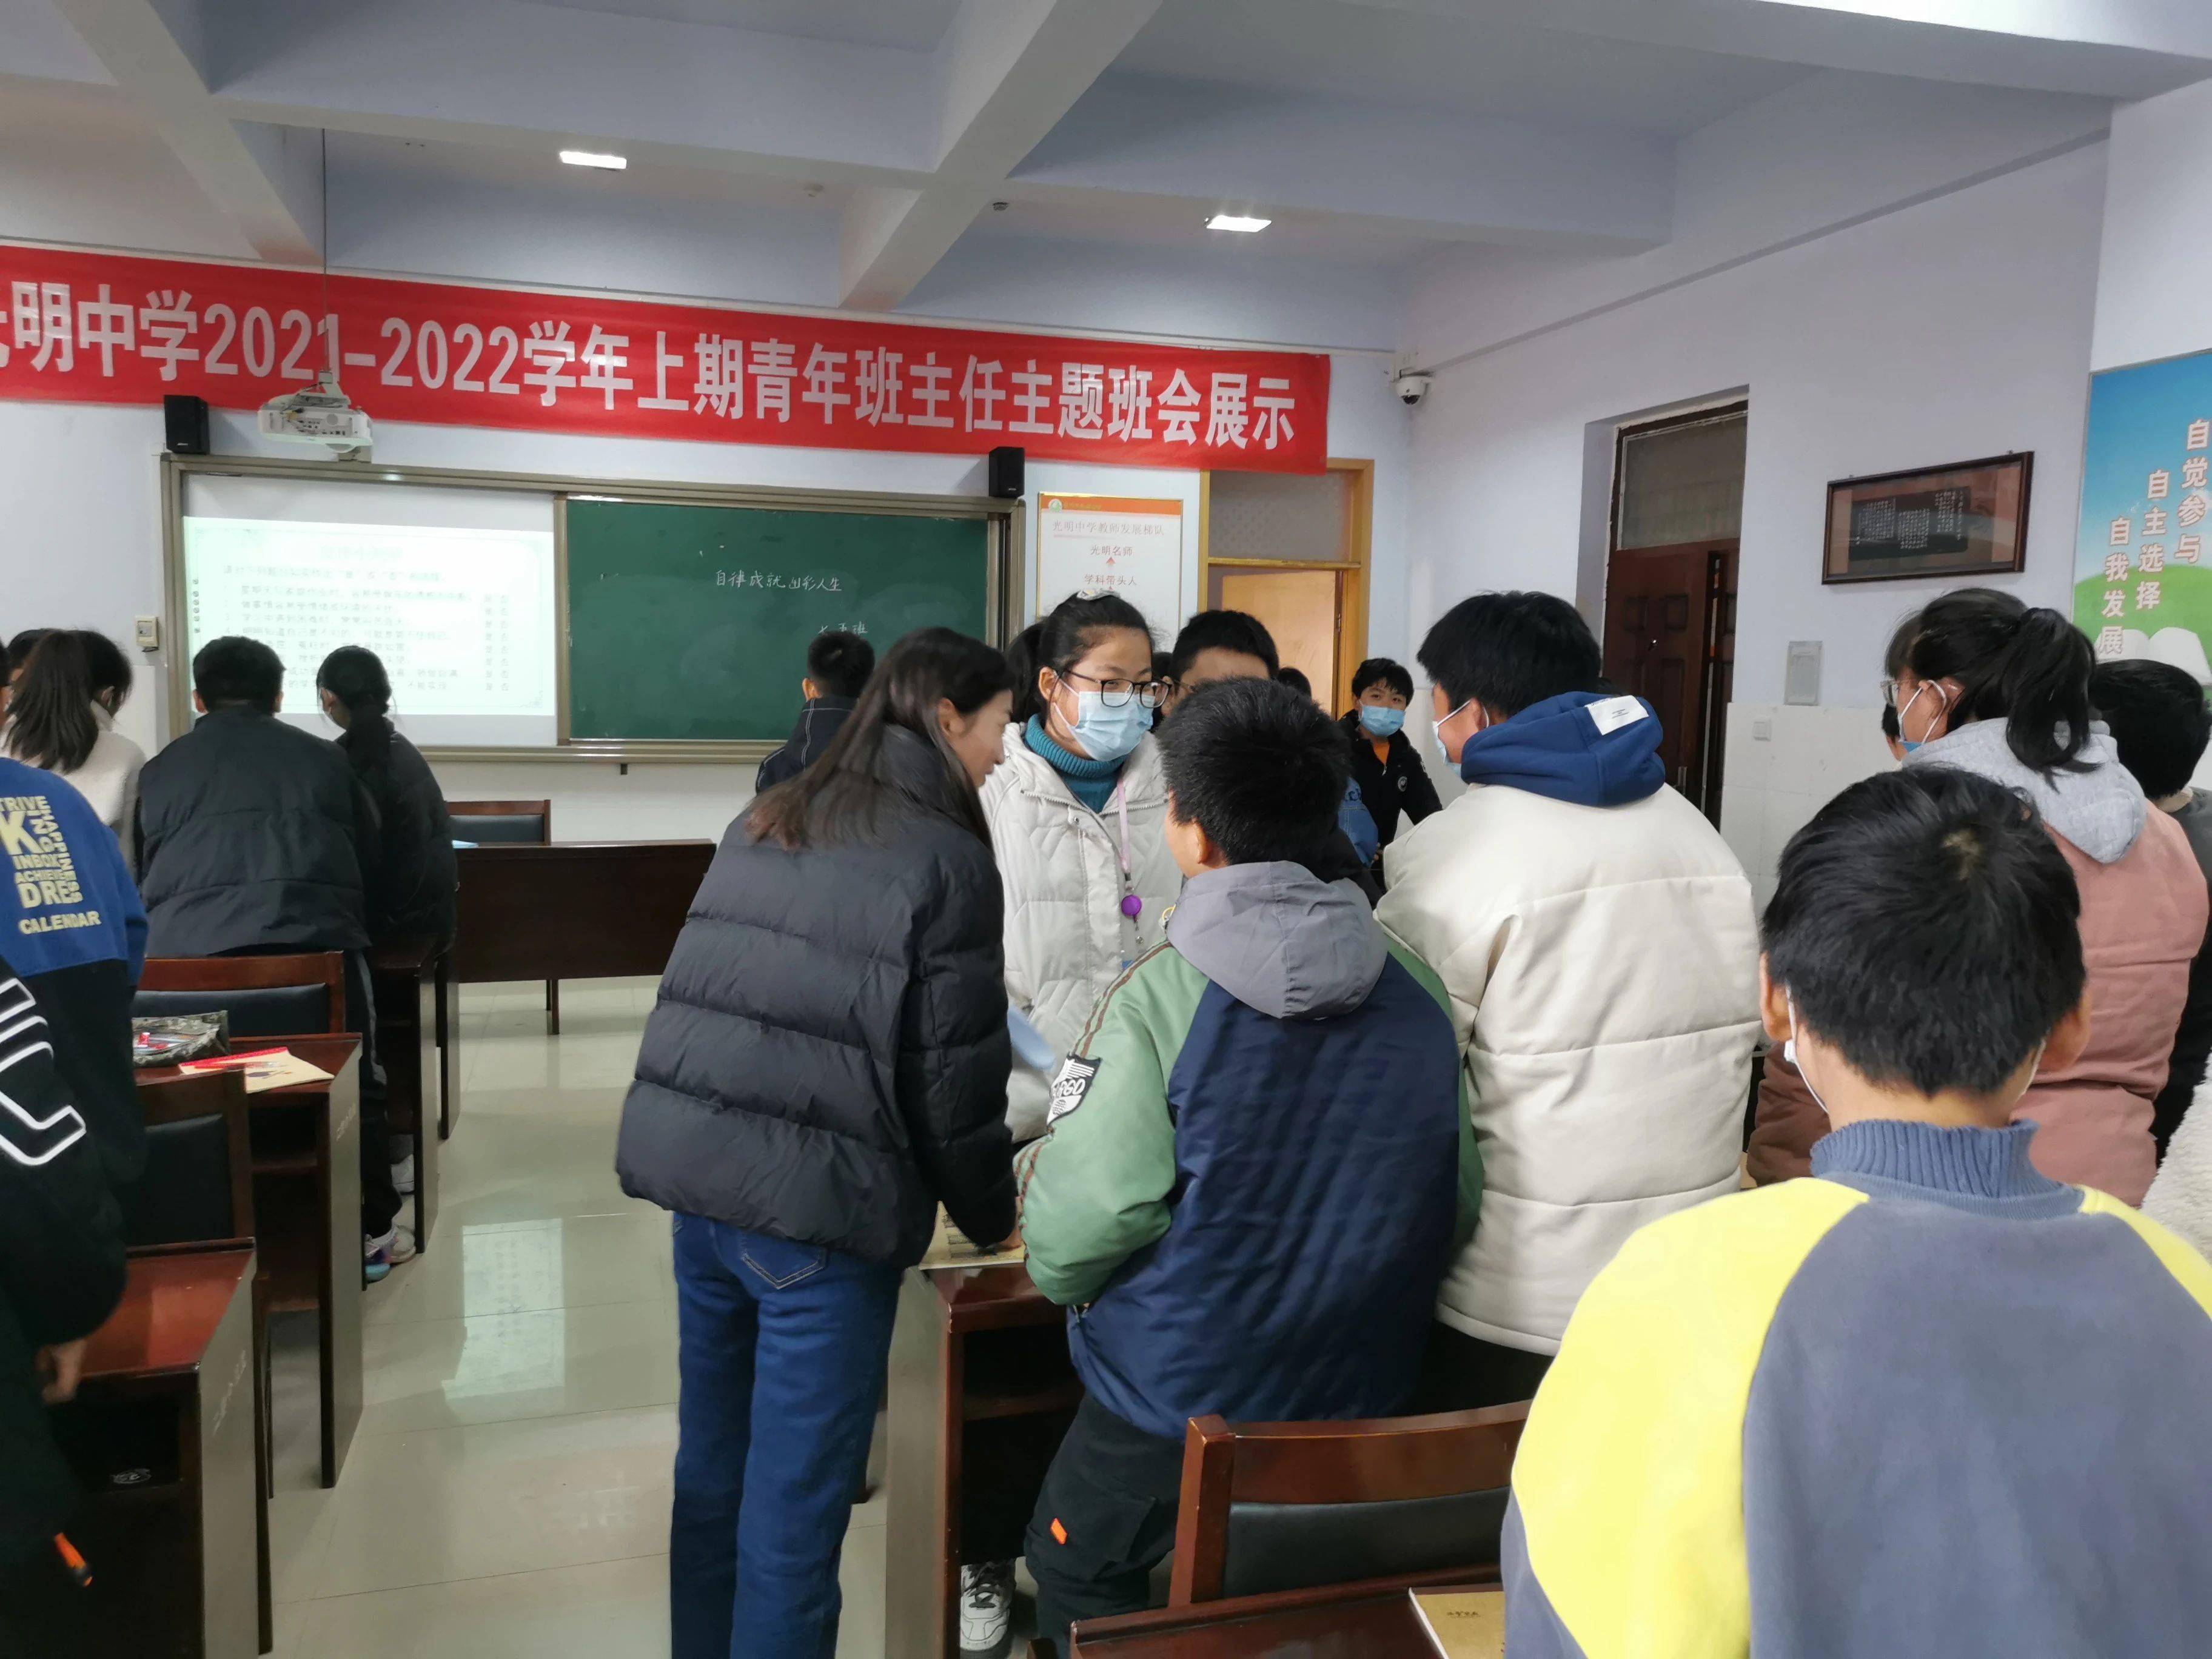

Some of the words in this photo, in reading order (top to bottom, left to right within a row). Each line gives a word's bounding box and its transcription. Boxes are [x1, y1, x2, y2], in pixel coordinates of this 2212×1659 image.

[0, 281, 1295, 450] 明中学2021-2022学年上期青年班主任主题班会展示
[1052, 520, 1164, 535] 光明中学教师发展梯队
[2174, 418, 2210, 564] 自觉参与
[1090, 545, 1133, 557] 光明名师
[2136, 469, 2170, 610] 自主选择
[716, 569, 842, 592] 自律成就出彩人生
[1084, 574, 1138, 586] 学科带头人
[2097, 516, 2131, 654] 自我发展
